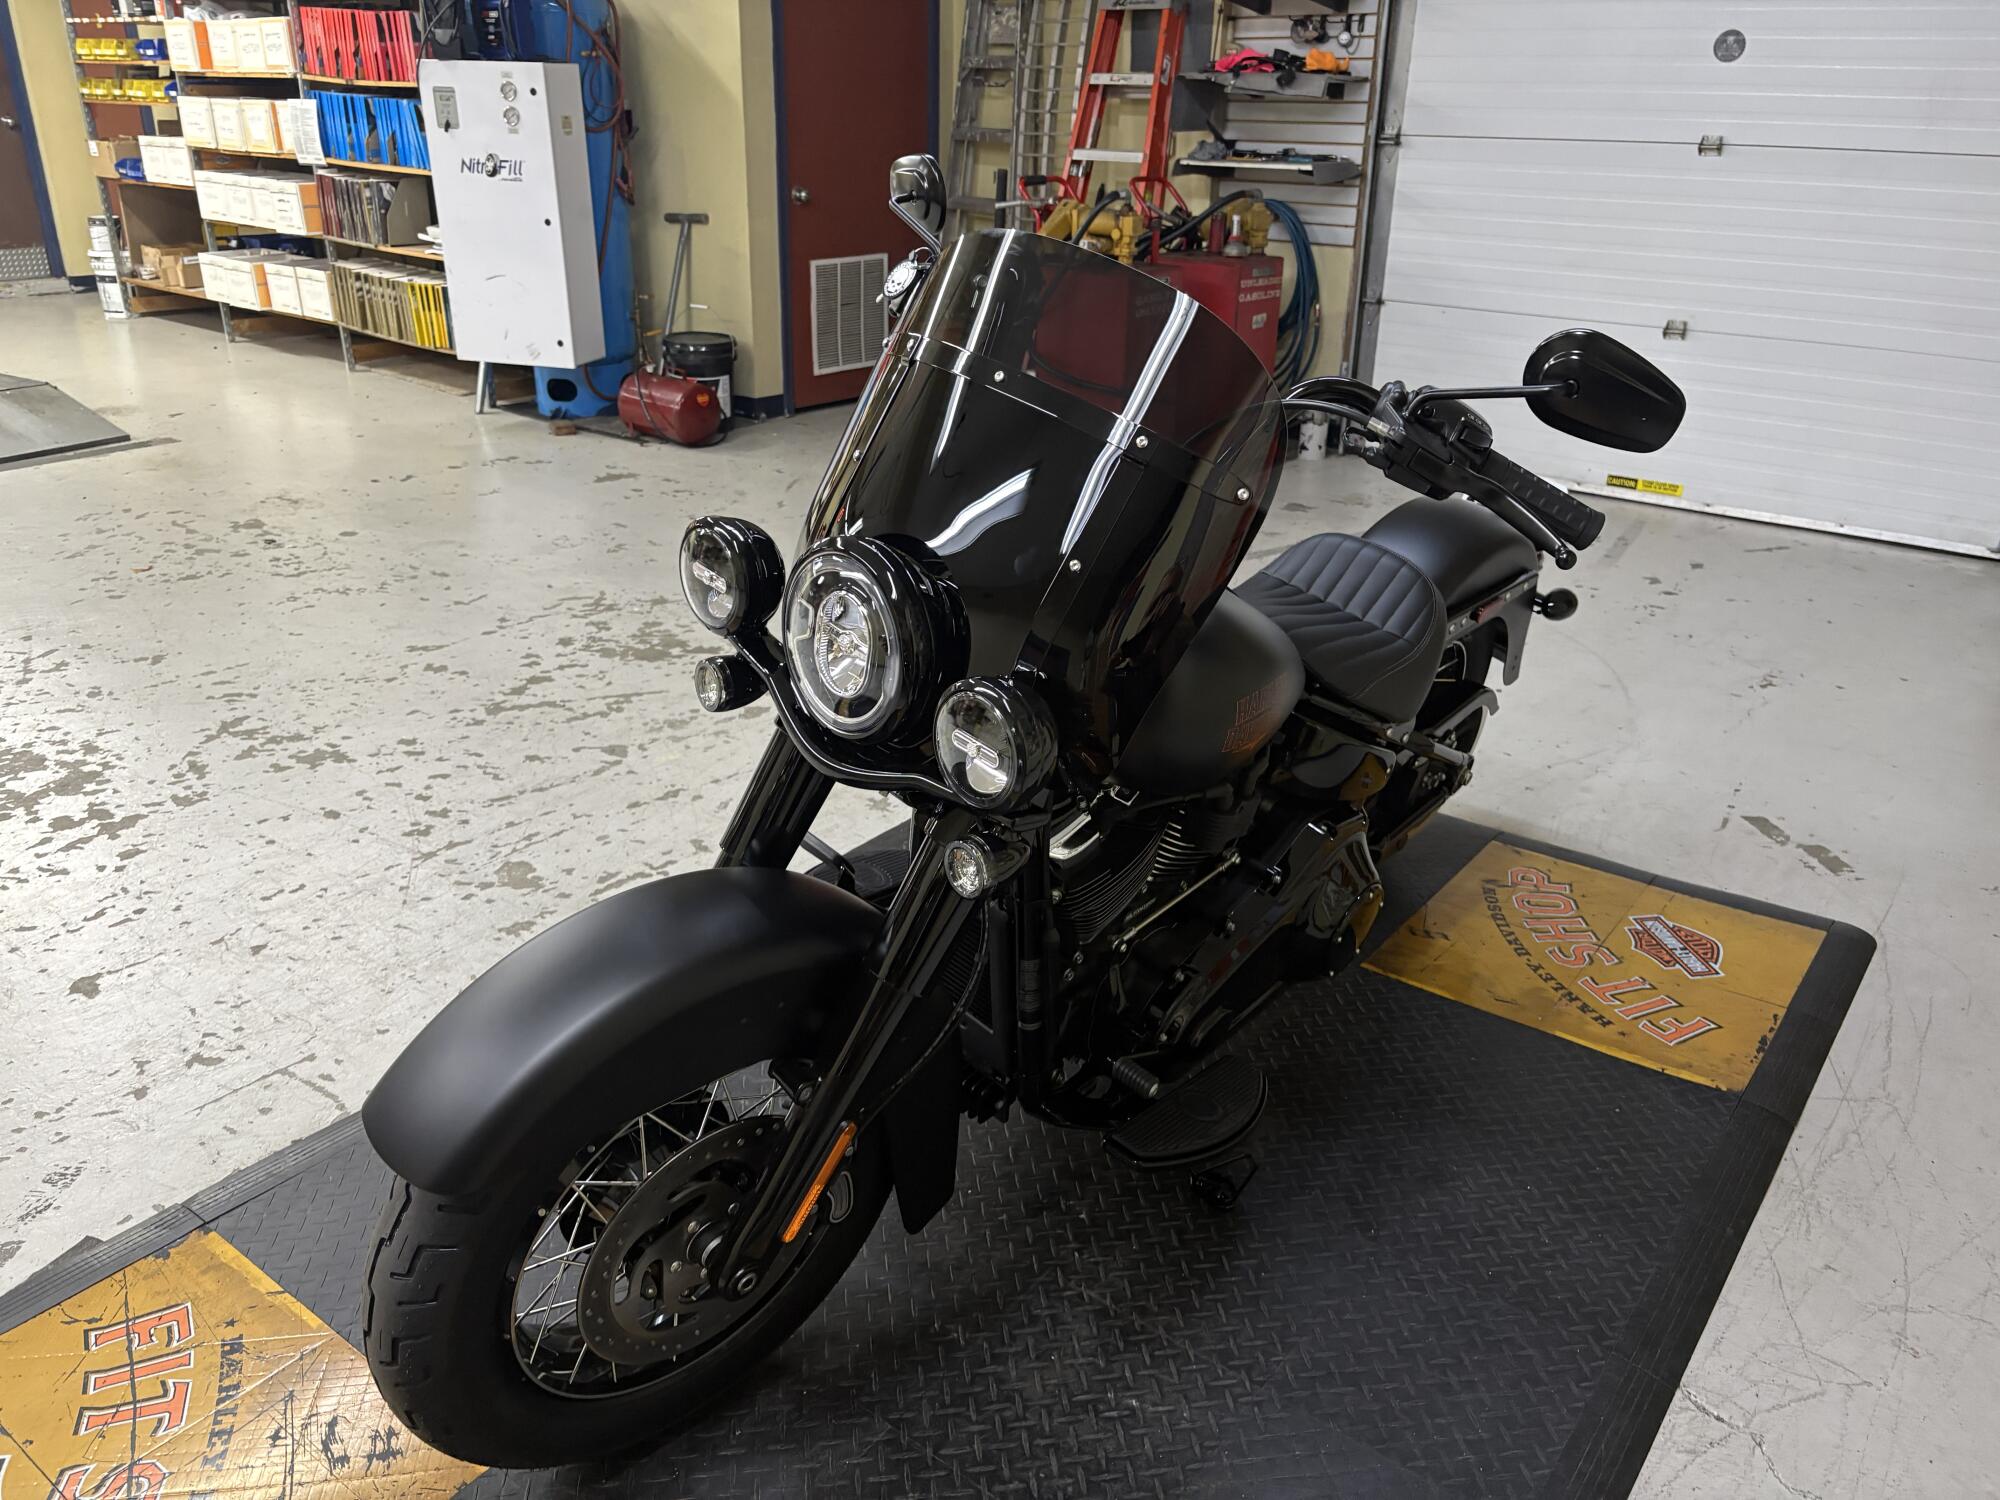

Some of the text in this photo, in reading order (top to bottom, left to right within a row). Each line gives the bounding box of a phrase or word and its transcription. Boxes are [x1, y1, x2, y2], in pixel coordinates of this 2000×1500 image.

[1238, 289, 1281, 303] GASOLINE
[1607, 476, 1636, 488] CAUTION
[1507, 866, 1723, 1046] FIT SHOP
[72, 1301, 196, 1436] FIT
